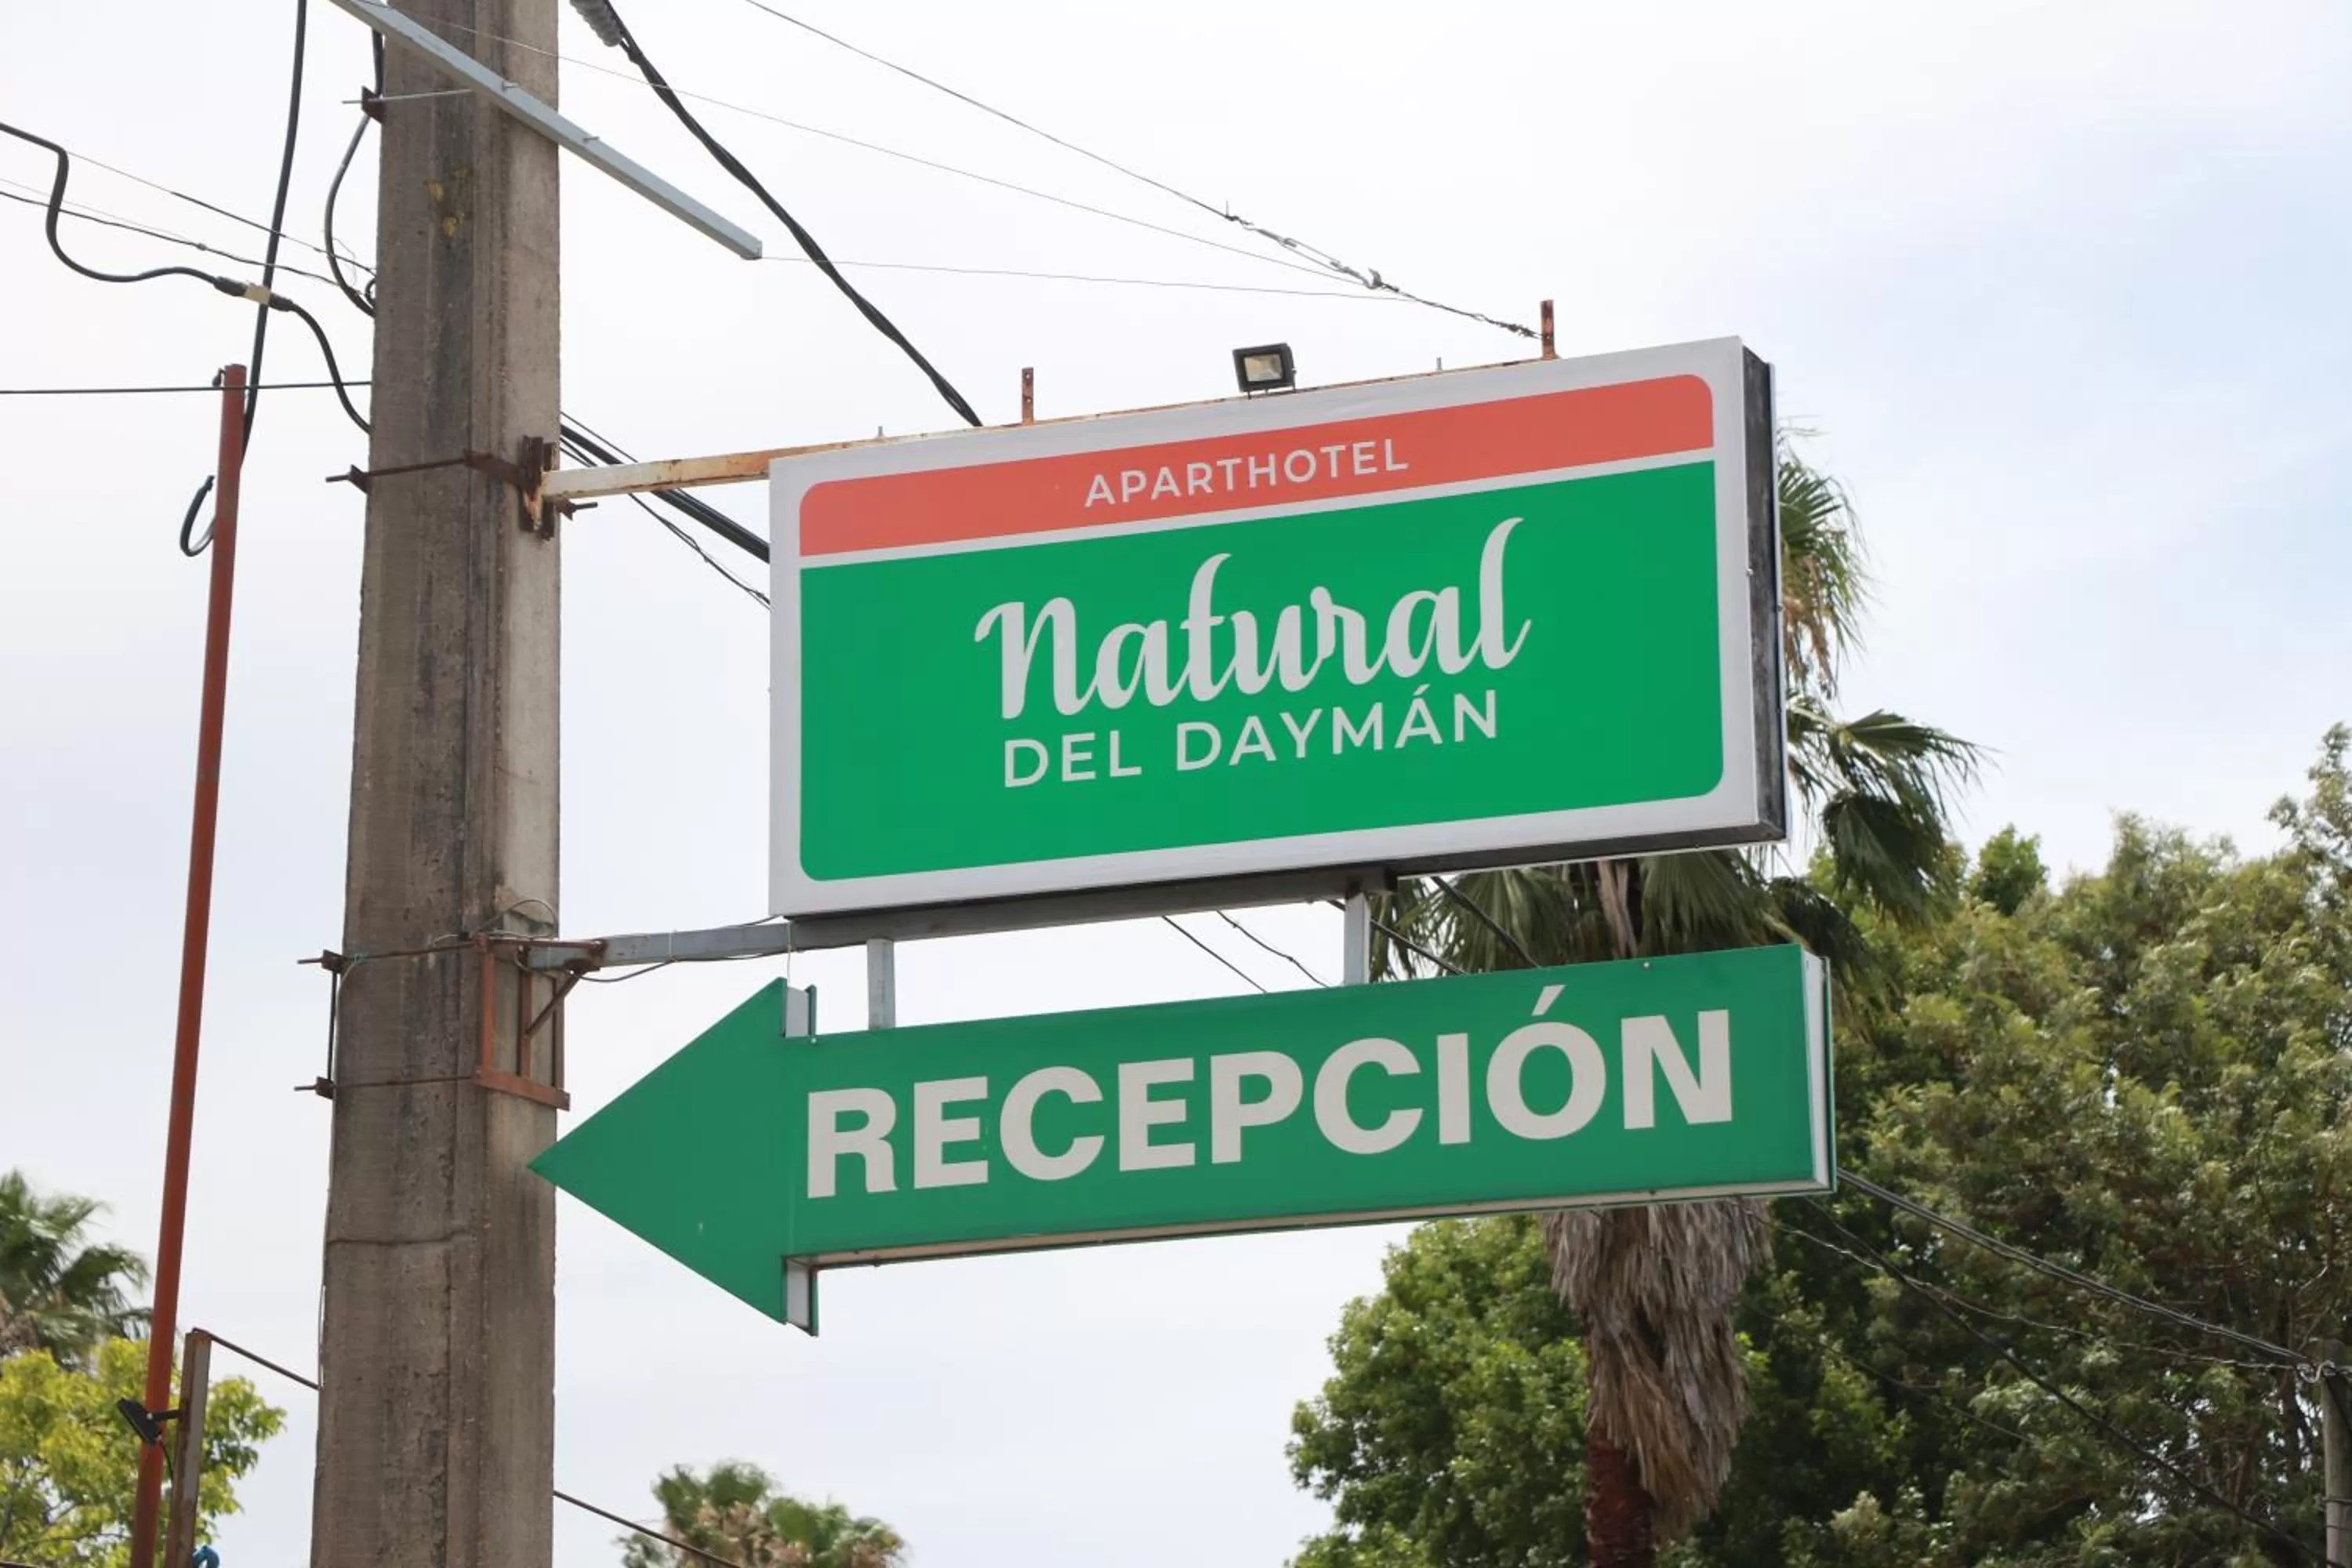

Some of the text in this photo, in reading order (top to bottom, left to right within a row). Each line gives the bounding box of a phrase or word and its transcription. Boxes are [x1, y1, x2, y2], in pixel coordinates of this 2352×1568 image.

[1084, 438, 1409, 508] APARTHOTEL
[1004, 684, 1497, 787] DEL DAYMÁN
[807, 985, 1733, 1199] RECEPCIÓN
